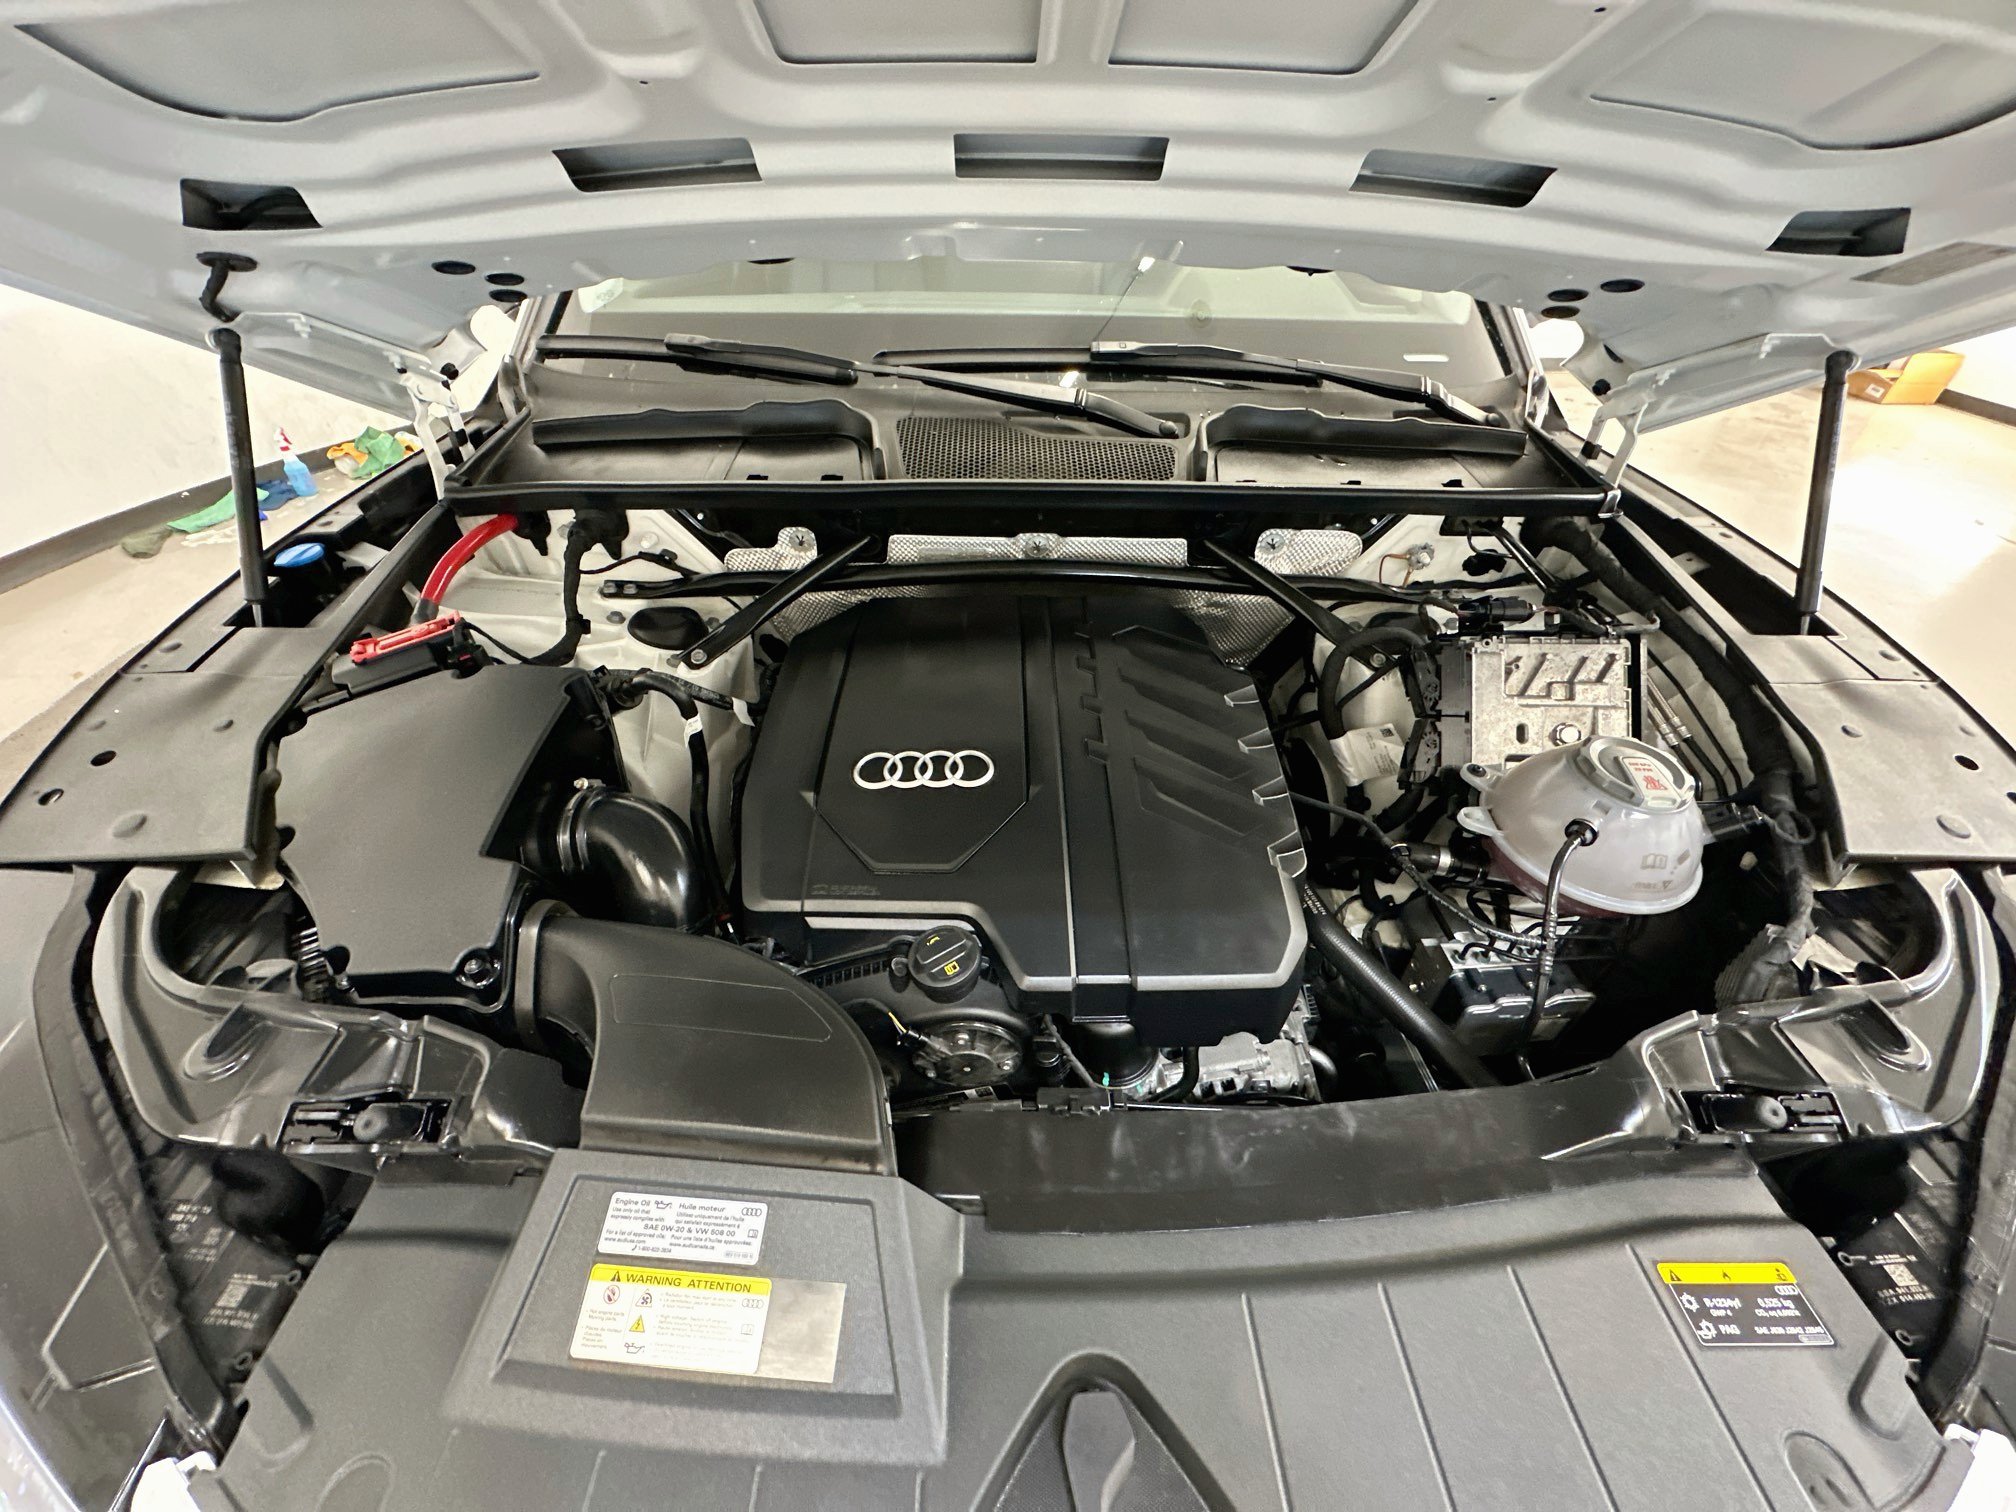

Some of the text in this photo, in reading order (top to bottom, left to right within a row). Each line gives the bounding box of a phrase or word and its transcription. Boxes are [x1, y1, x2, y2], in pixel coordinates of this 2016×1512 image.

[615, 1197, 639, 1206] Engine
[660, 1224, 685, 1232] 0W-20
[626, 1273, 752, 1293] WARNING ATTENTION
